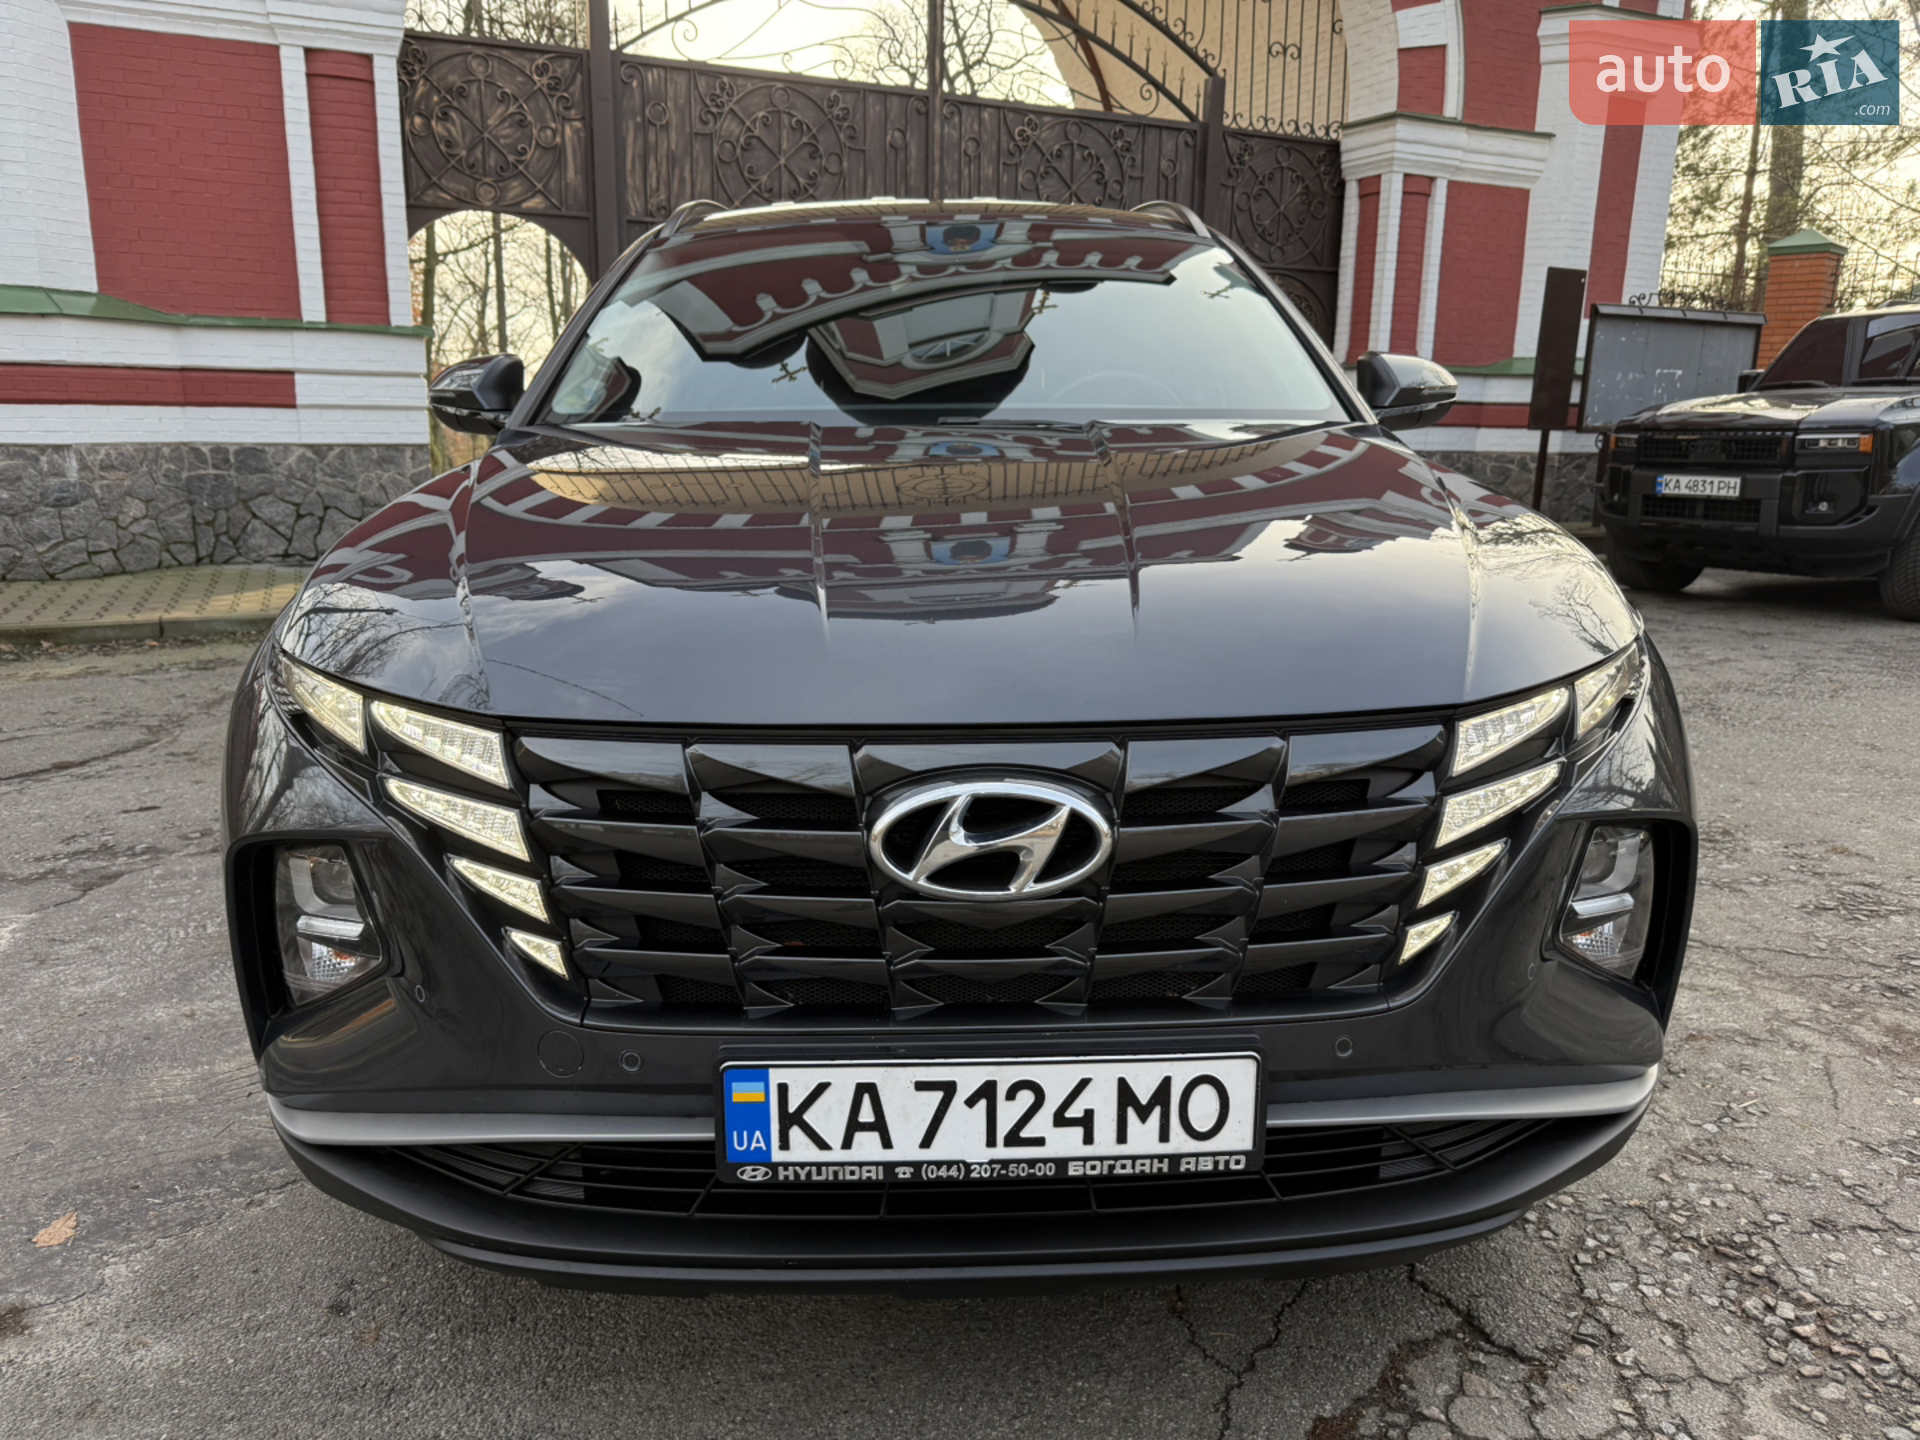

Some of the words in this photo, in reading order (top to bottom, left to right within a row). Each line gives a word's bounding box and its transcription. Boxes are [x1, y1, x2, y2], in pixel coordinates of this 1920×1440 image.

[1664, 477, 1681, 492] KA
[1684, 478, 1714, 493] 4831
[1717, 480, 1738, 494] PH
[777, 1081, 894, 1151] KA
[914, 1077, 1095, 1149] 7124
[1116, 1073, 1230, 1145] MO
[732, 1130, 767, 1151] UA
[778, 1165, 884, 1181] HYUNDAI
[921, 1163, 965, 1180] (044)
[970, 1162, 1056, 1178] 207-50-00
[1067, 1158, 1169, 1176] БОГДАН
[1180, 1155, 1246, 1172] АВТО
